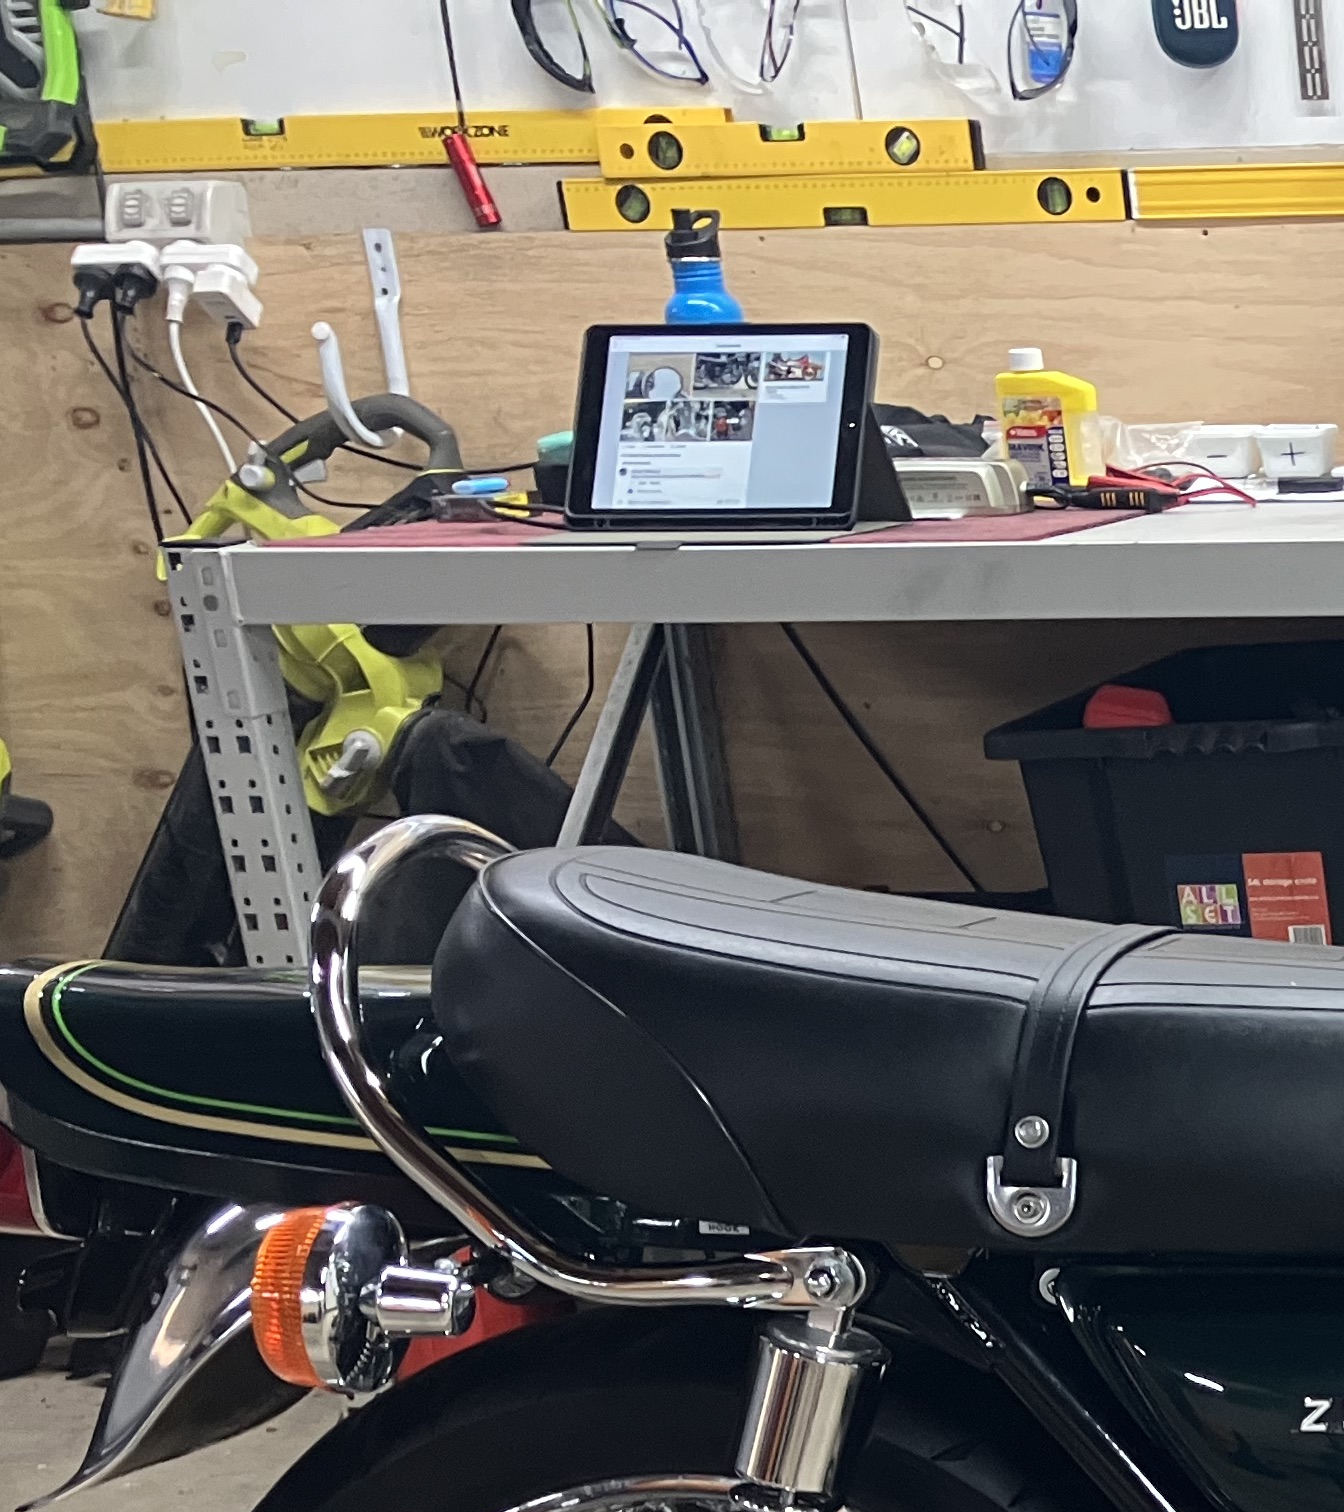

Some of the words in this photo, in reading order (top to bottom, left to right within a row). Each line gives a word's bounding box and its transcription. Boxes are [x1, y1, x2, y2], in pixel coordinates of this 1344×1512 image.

[1174, 0, 1228, 30] JBL
[1182, 885, 1236, 904] ALL
[1184, 905, 1238, 924] SET
